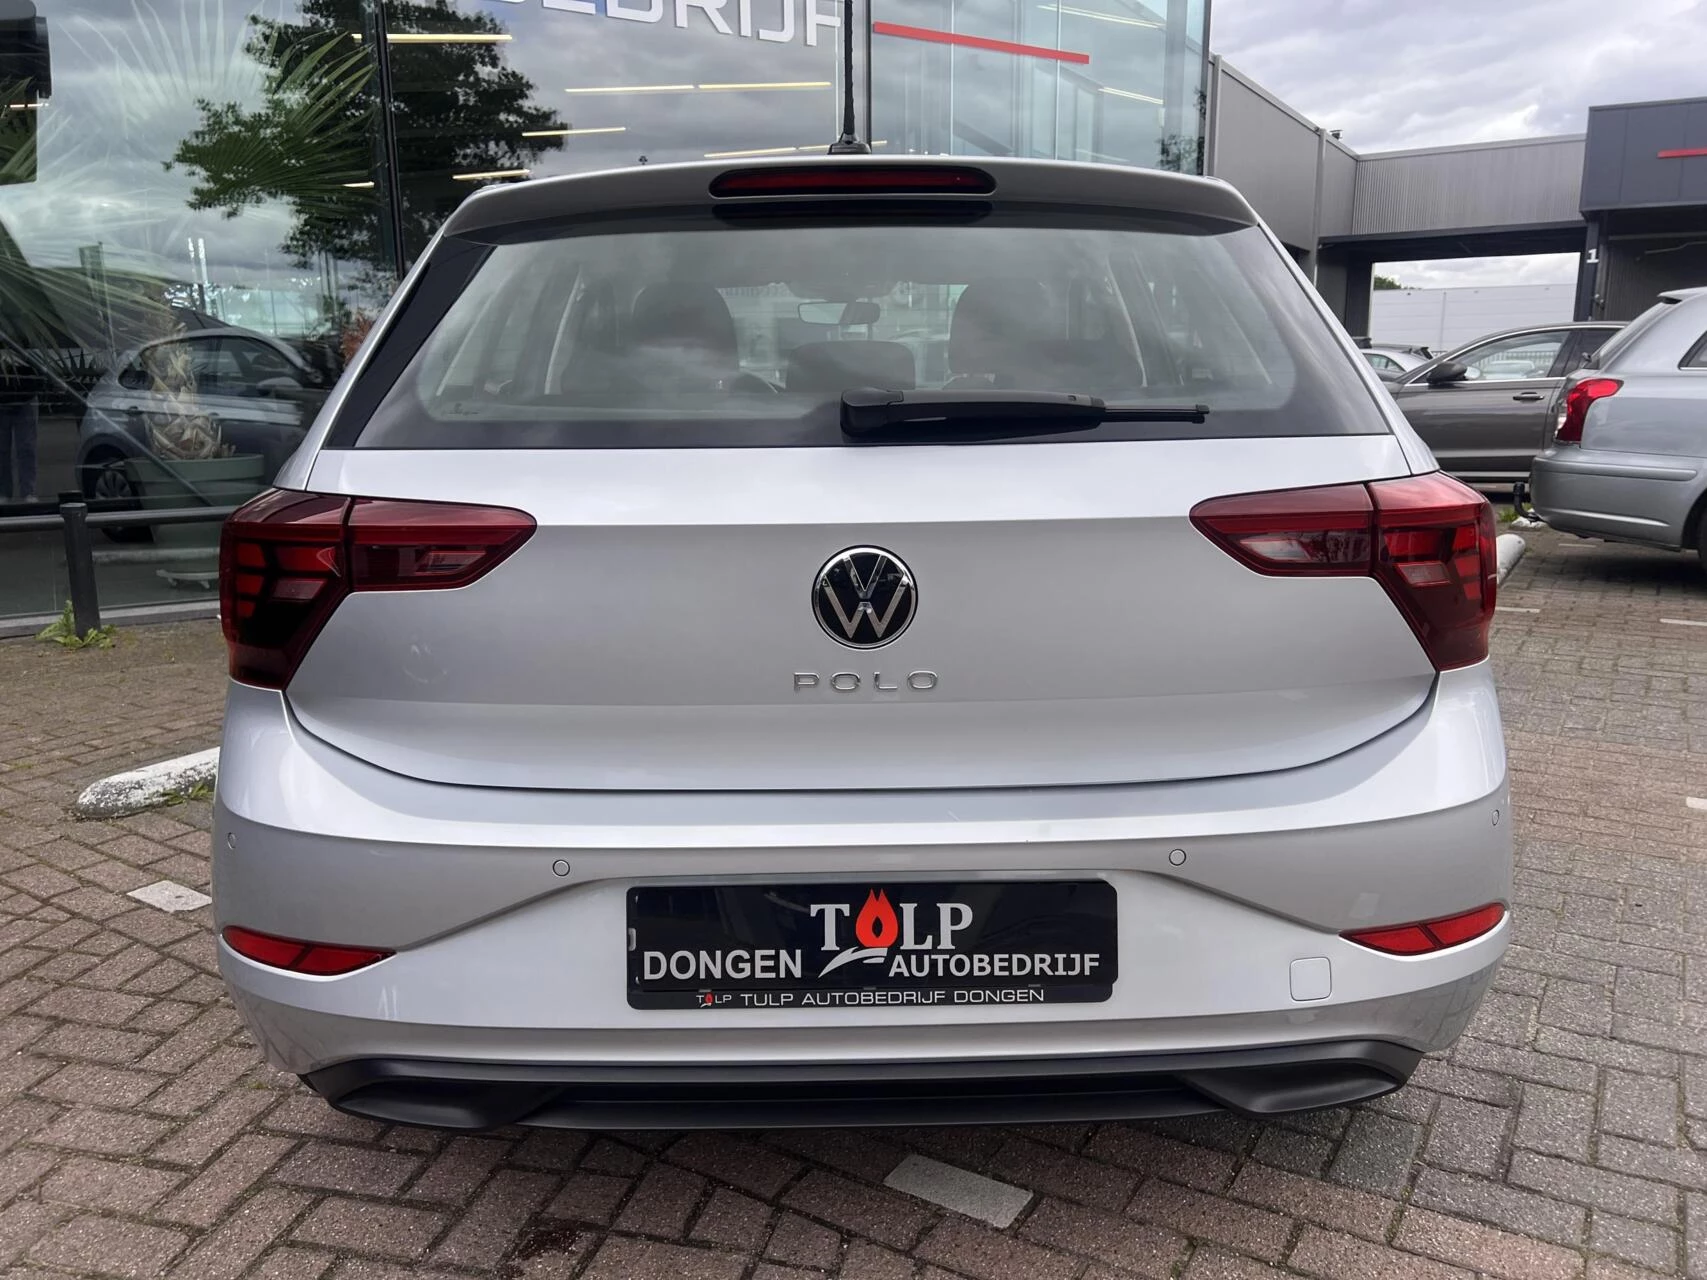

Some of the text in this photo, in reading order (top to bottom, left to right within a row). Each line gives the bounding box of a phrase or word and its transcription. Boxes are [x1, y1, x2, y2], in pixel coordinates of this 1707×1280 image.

[487, 0, 842, 46] RIJF
[1586, 248, 1600, 264] 1
[793, 670, 938, 692] POLO
[643, 949, 1100, 981] DONGEN AUTOBEDRIJF
[740, 993, 794, 1006] TULP
[801, 990, 945, 1006] AUTOBEDRIJF
[954, 989, 1044, 1003] DONGEN
